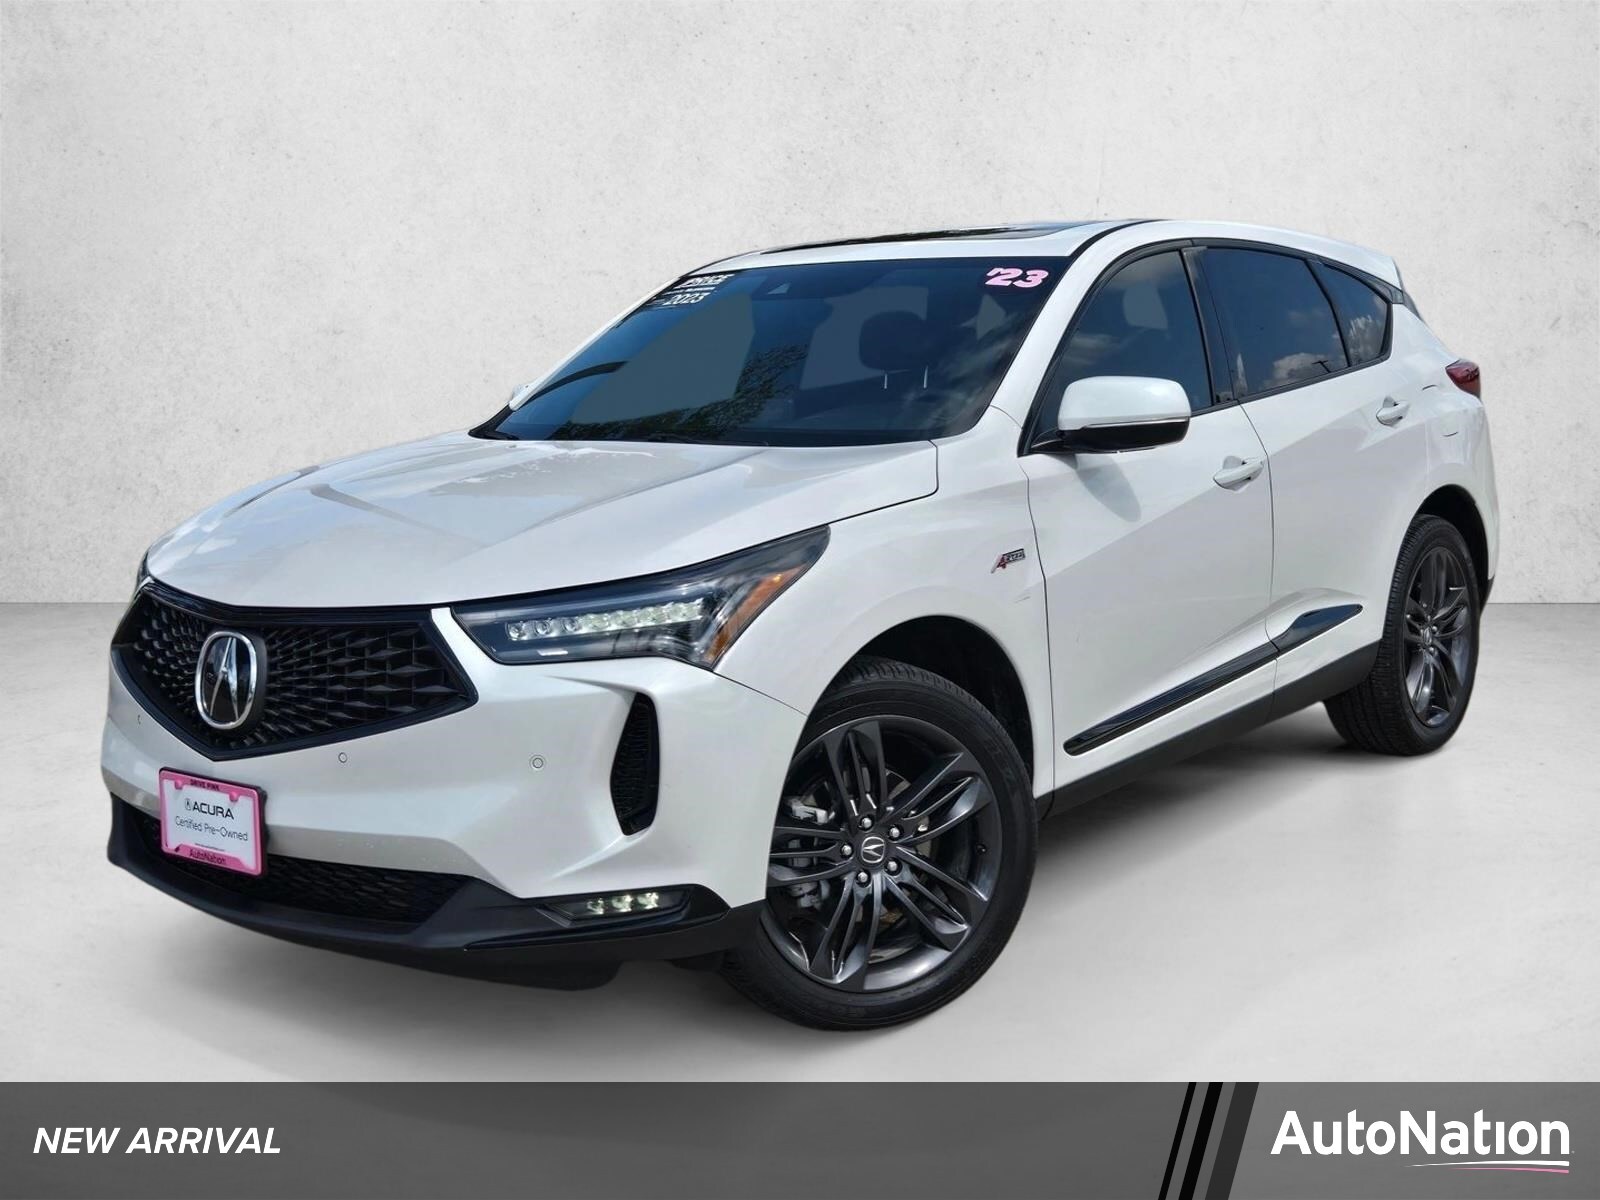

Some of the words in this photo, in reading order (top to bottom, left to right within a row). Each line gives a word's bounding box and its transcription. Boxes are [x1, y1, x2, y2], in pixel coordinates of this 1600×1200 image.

[662, 292, 711, 306] 2023
[193, 802, 234, 820] ACURA
[175, 815, 202, 832] Certified
[204, 822, 249, 841] Pre-Owned
[190, 849, 226, 865] AutoNation
